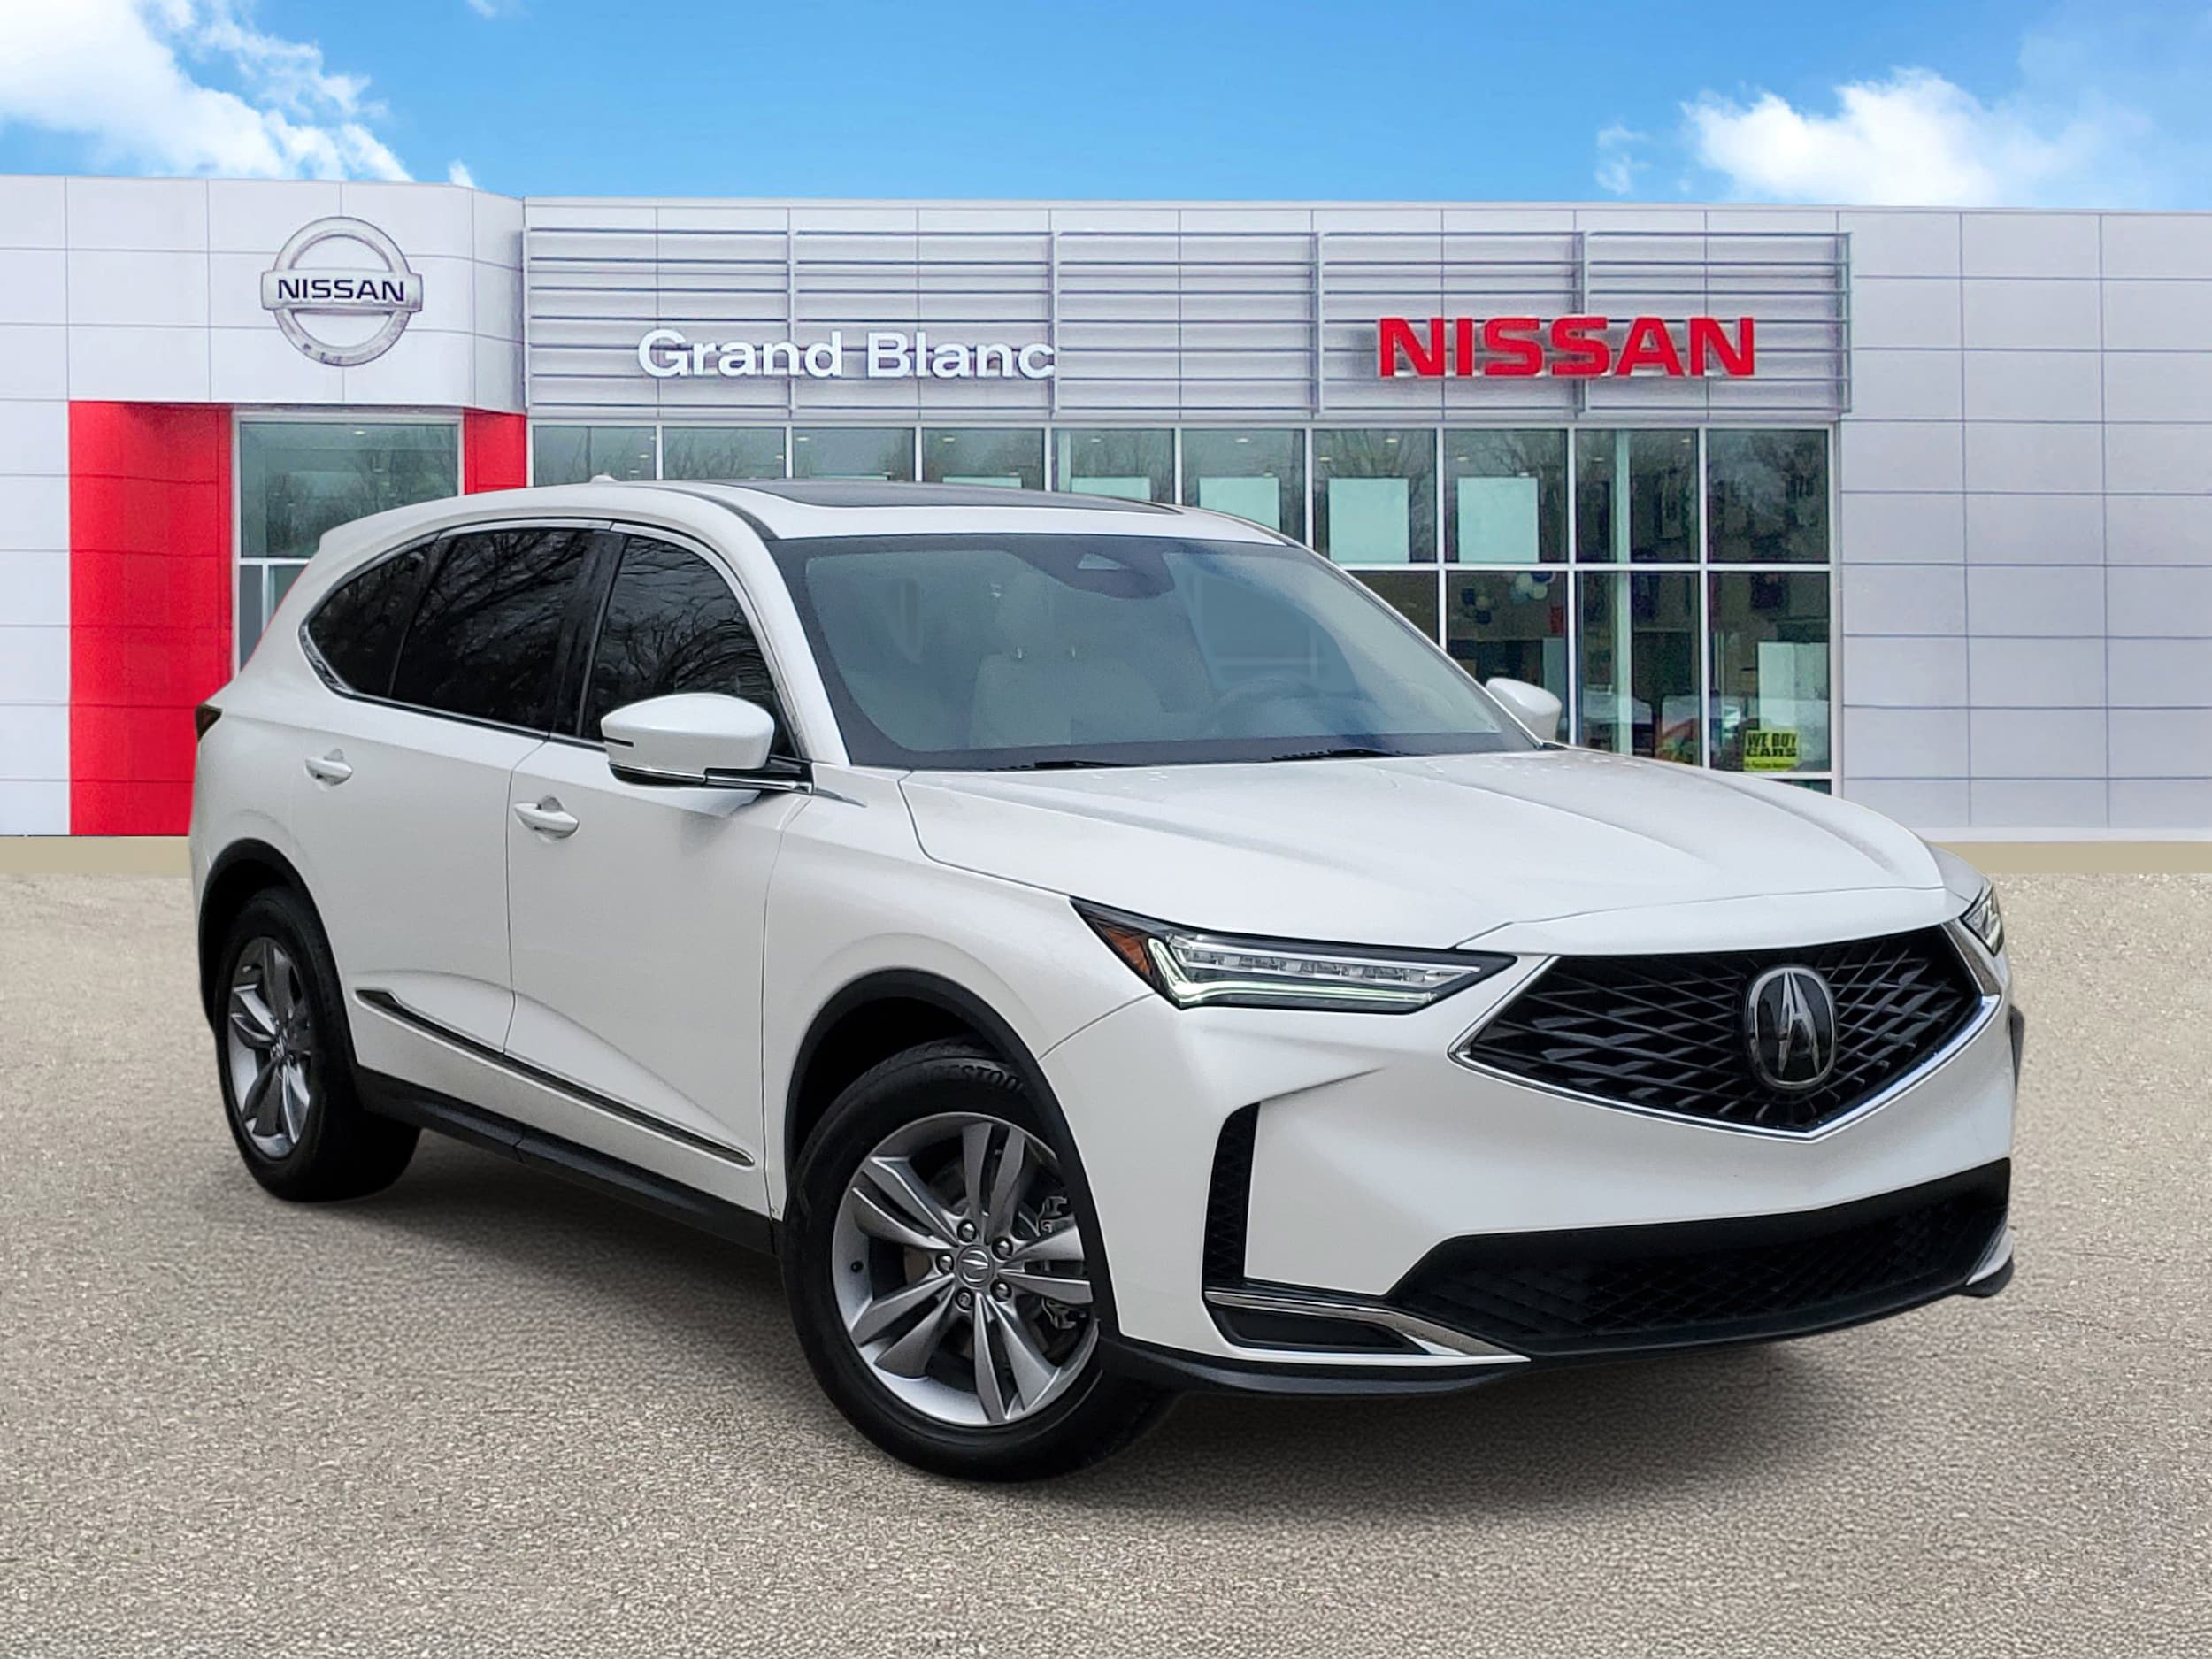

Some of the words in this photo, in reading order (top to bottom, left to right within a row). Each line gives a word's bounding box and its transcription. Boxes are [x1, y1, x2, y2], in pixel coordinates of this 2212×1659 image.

[278, 278, 405, 302] NISSAN
[637, 328, 841, 379] Grand
[865, 330, 1056, 380] Blanc
[1377, 315, 1756, 378] NISSAN
[1746, 747, 1798, 757] CARS
[1747, 733, 1769, 747] WE
[1771, 733, 1798, 747] BUY
